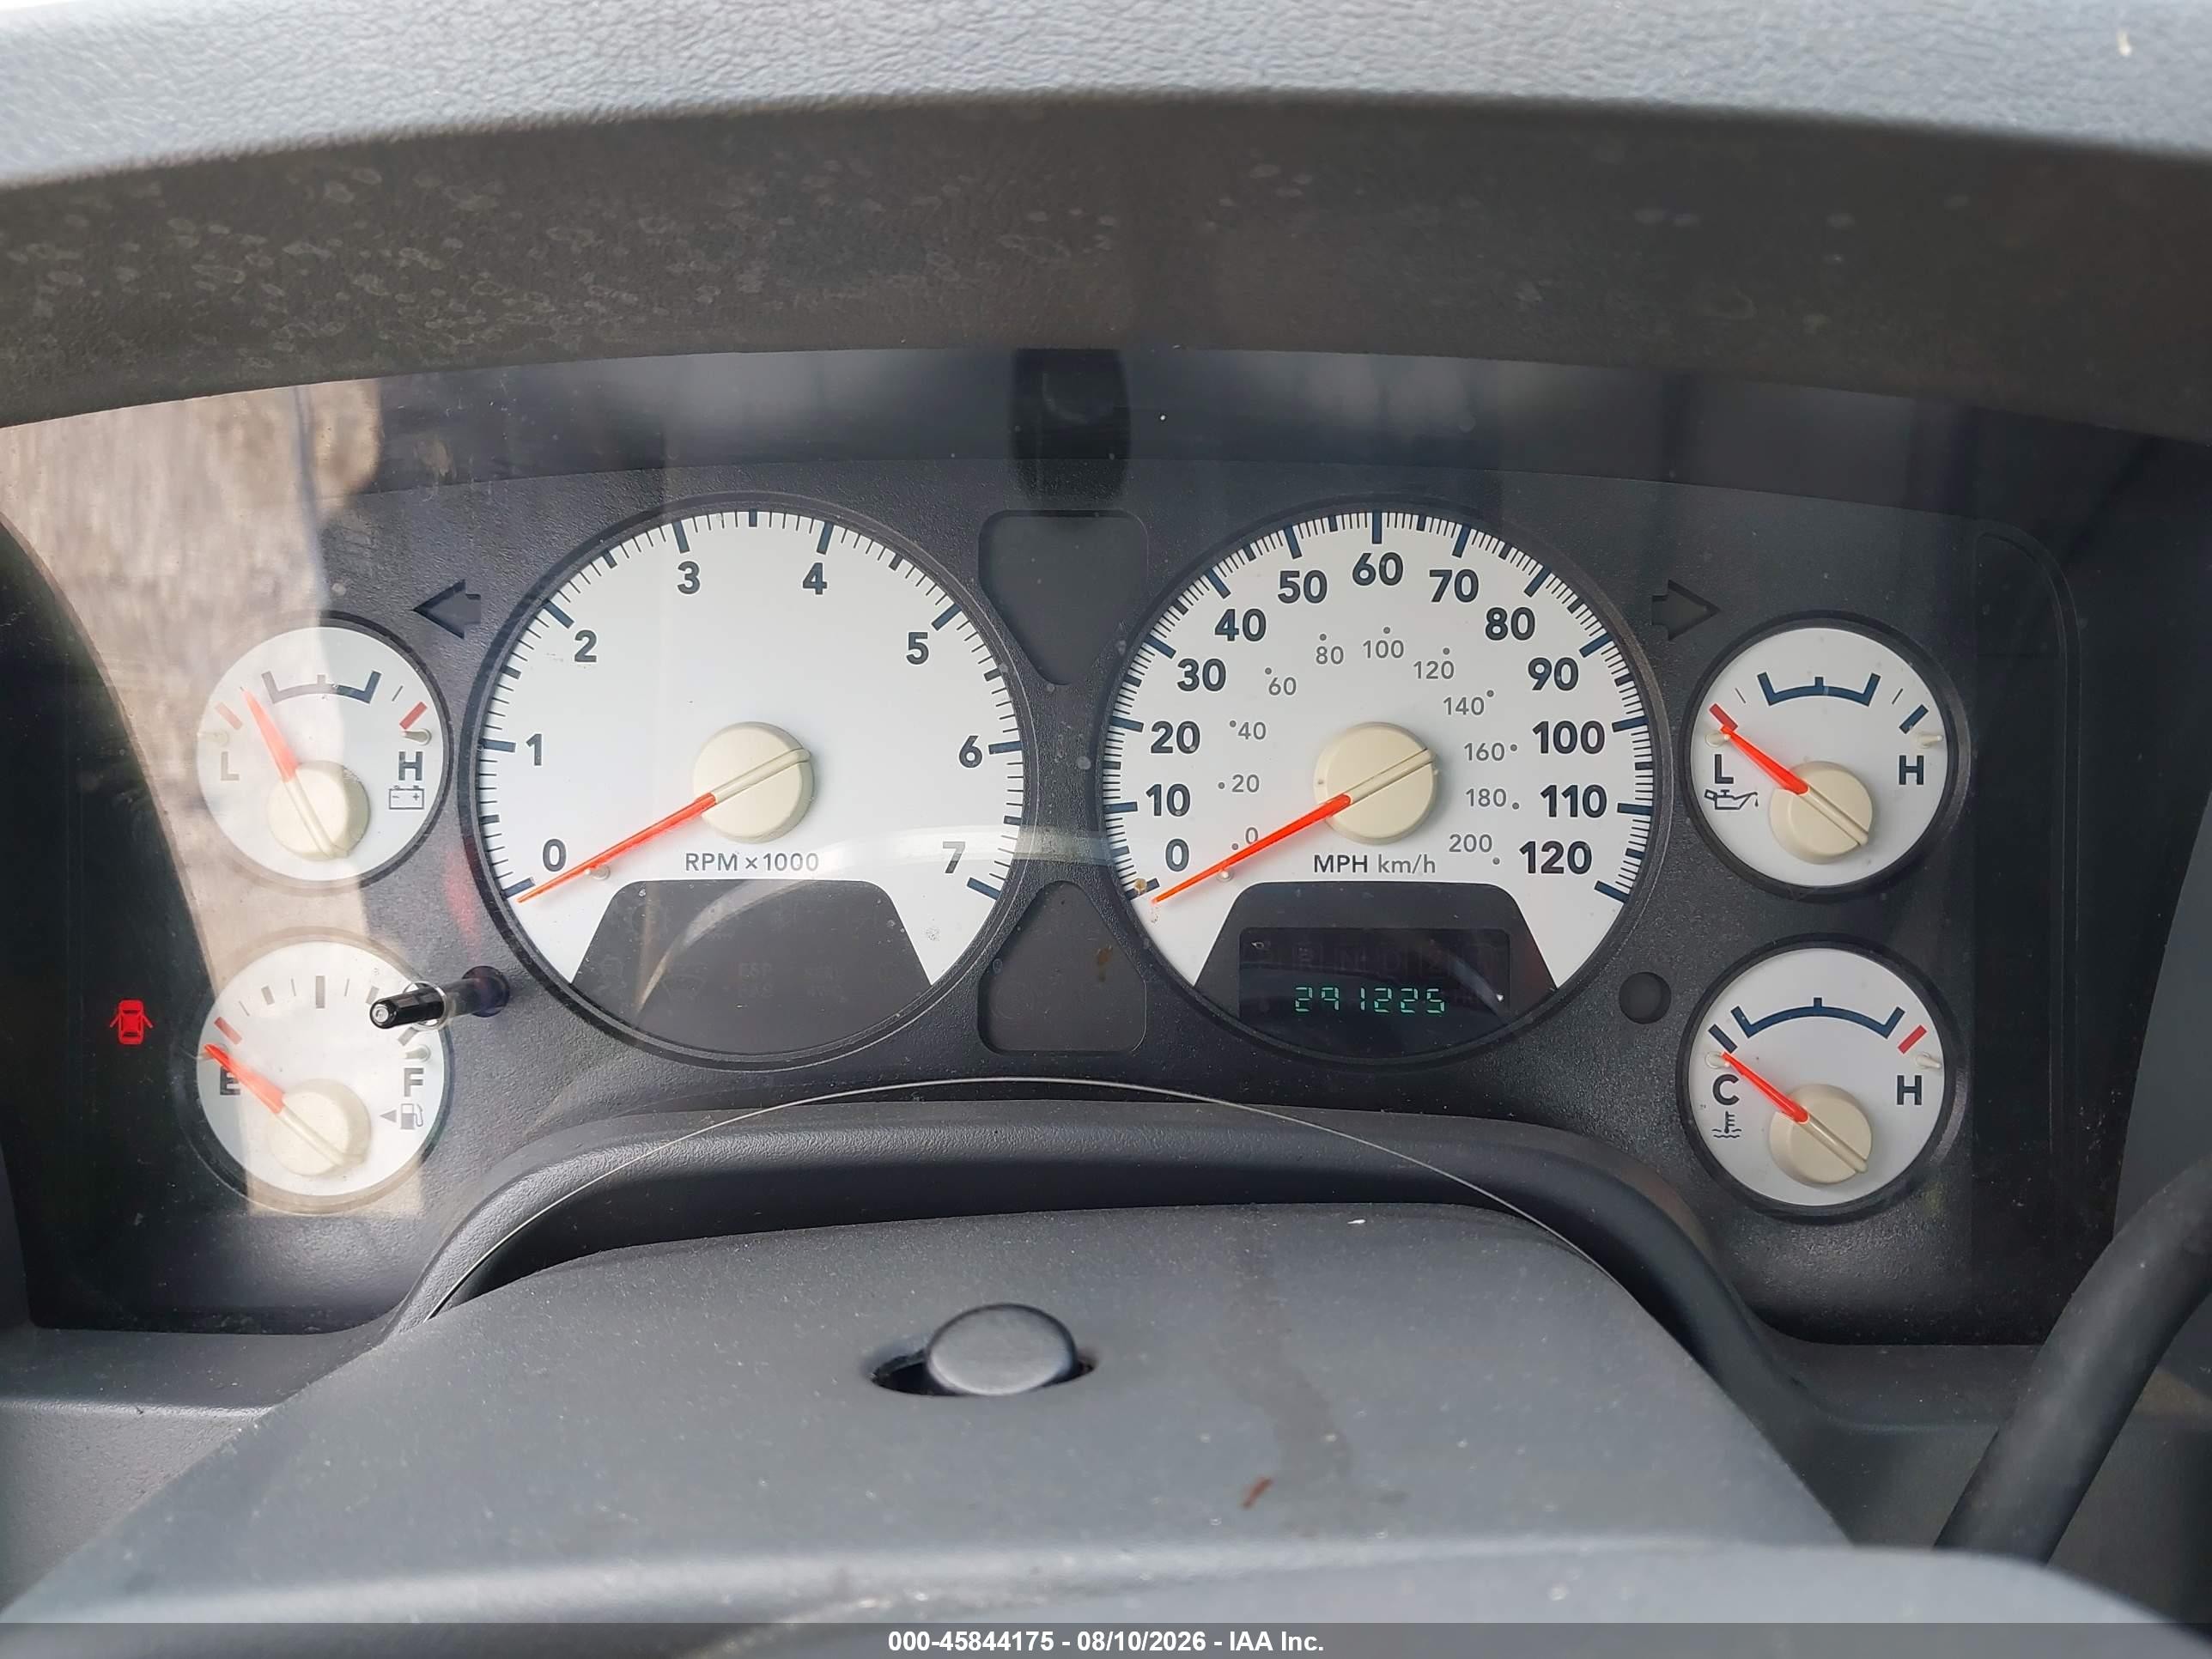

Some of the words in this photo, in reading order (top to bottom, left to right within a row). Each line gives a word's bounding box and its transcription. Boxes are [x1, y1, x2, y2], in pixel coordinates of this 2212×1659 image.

[678, 561, 700, 594] 3
[803, 562, 827, 594] 4
[1352, 552, 1403, 586] 60
[1278, 570, 1327, 604] 50
[1430, 569, 1479, 602] 70
[1215, 609, 1266, 641] 40
[1486, 607, 1534, 641] 80
[574, 630, 597, 662] 2
[907, 632, 928, 665] 5
[1316, 647, 1343, 665] 80
[1363, 641, 1403, 658] 100
[1177, 659, 1226, 691] 30
[1413, 661, 1454, 679] 120
[1528, 658, 1578, 690] 90
[1269, 678, 1296, 696] 60
[1443, 697, 1484, 715] 140
[1151, 721, 1200, 754] 20
[1238, 722, 1266, 739] 40
[1533, 720, 1605, 754] 100
[526, 734, 542, 766] 1
[959, 736, 982, 768] 6
[1464, 743, 1504, 761] 160
[221, 751, 240, 781] L
[398, 751, 422, 781] H
[1715, 754, 1734, 784] L
[1899, 756, 1923, 785] H
[1232, 775, 1259, 793] 20
[1466, 788, 1506, 806] 180
[1146, 784, 1190, 817] 10
[1540, 785, 1607, 817] 110
[1244, 827, 1260, 845] 0
[1449, 834, 1492, 852] 200
[543, 839, 566, 872] 0
[685, 853, 738, 872] RPM
[942, 841, 965, 873] 7
[1165, 839, 1189, 872] 0
[1315, 855, 1367, 872] MPH
[1379, 854, 1435, 873] km/h
[1520, 841, 1592, 874] 120
[1294, 987, 1445, 1012] 291225
[220, 1066, 240, 1096] E
[404, 1068, 424, 1097] F
[1713, 1074, 1739, 1105] C
[1897, 1075, 1922, 1105] H
